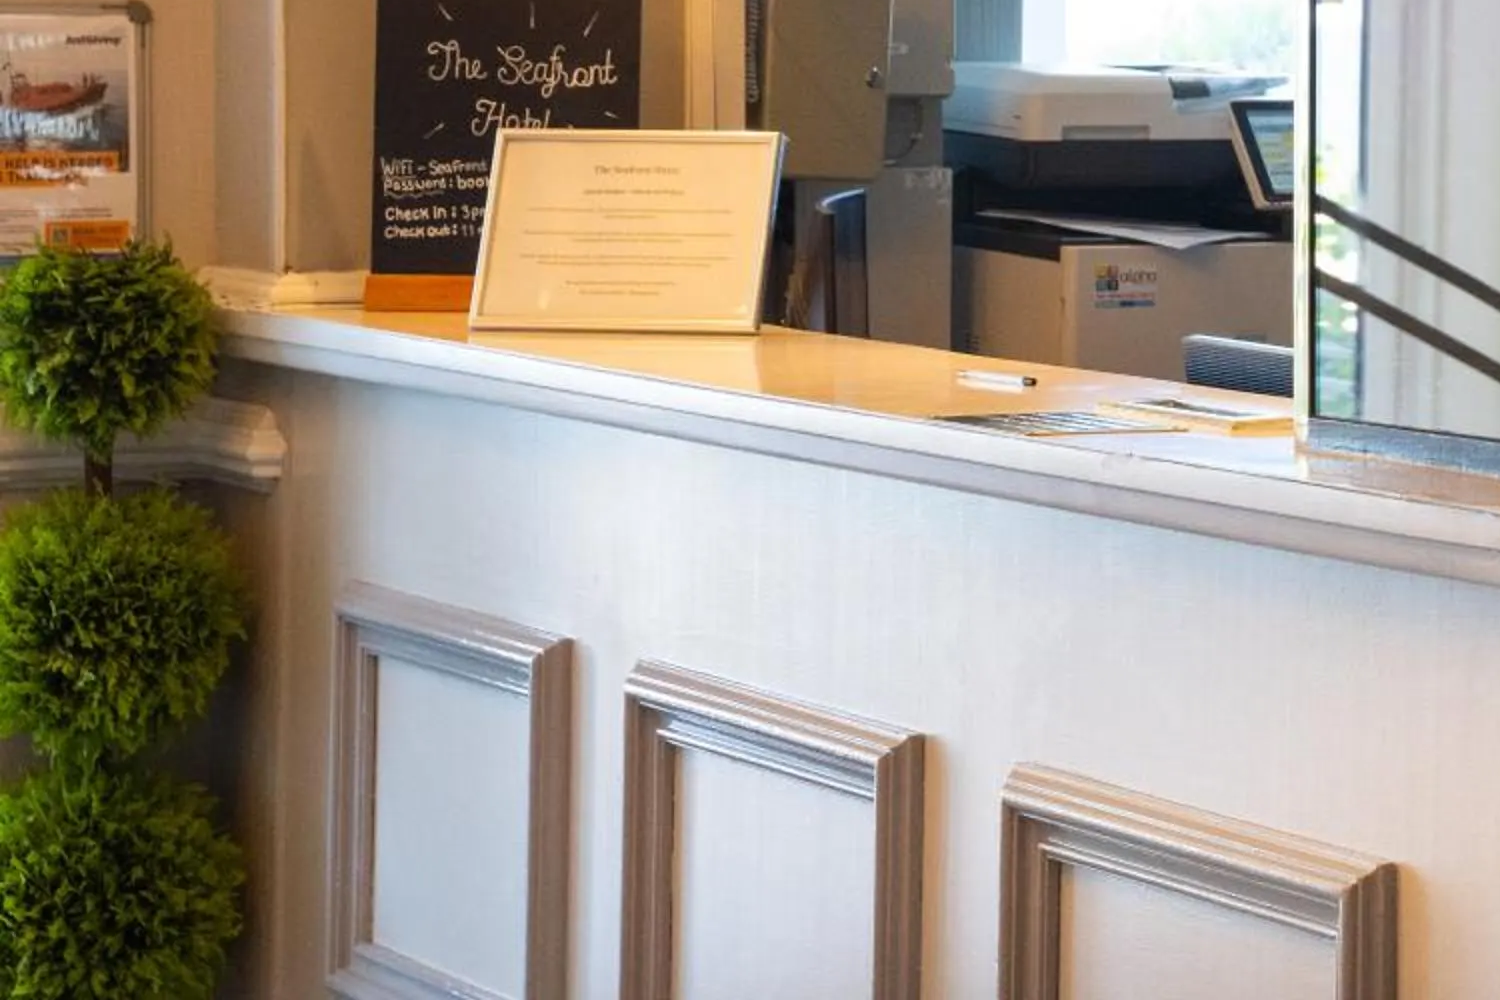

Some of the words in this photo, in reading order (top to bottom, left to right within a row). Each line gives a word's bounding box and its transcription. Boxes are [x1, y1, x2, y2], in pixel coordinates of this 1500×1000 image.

[427, 39, 488, 81] The
[496, 44, 618, 98] Seafront
[471, 99, 551, 136] Hotel
[384, 205, 429, 221] Check
